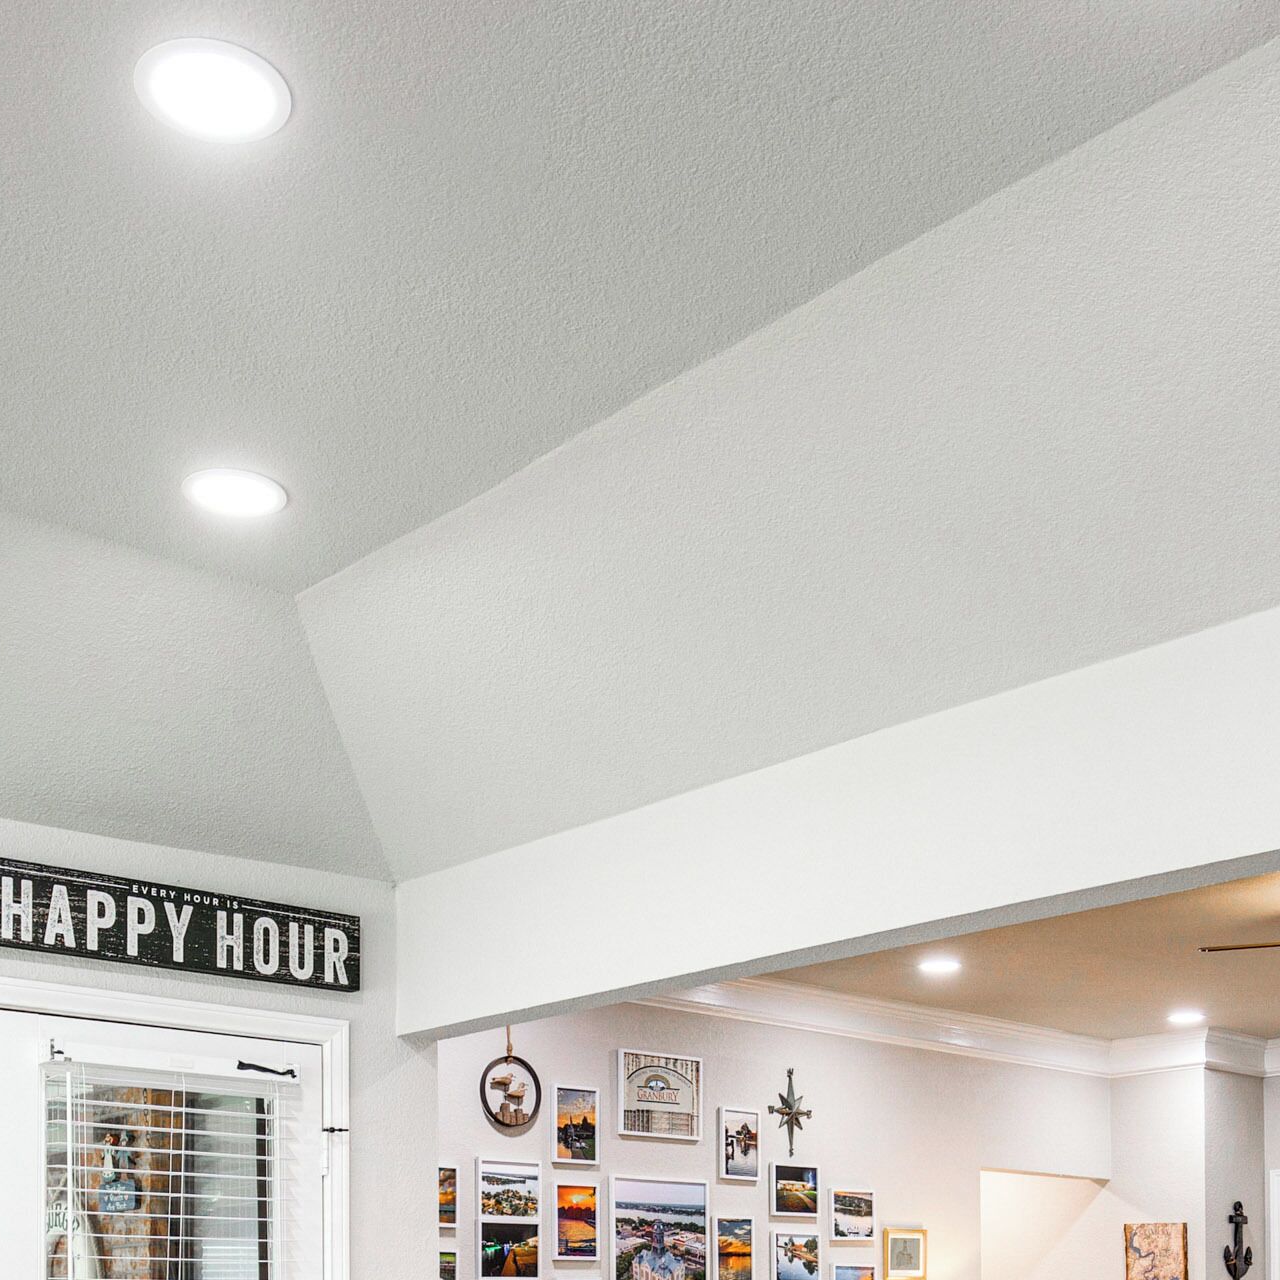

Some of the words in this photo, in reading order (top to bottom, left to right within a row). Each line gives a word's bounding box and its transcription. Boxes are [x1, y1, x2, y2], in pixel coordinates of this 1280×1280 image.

[1, 875, 194, 963] HAPPY
[216, 910, 349, 986] HOUR
[132, 884, 176, 899] EVERY
[184, 892, 219, 906] HOUR
[226, 900, 239, 909] IS
